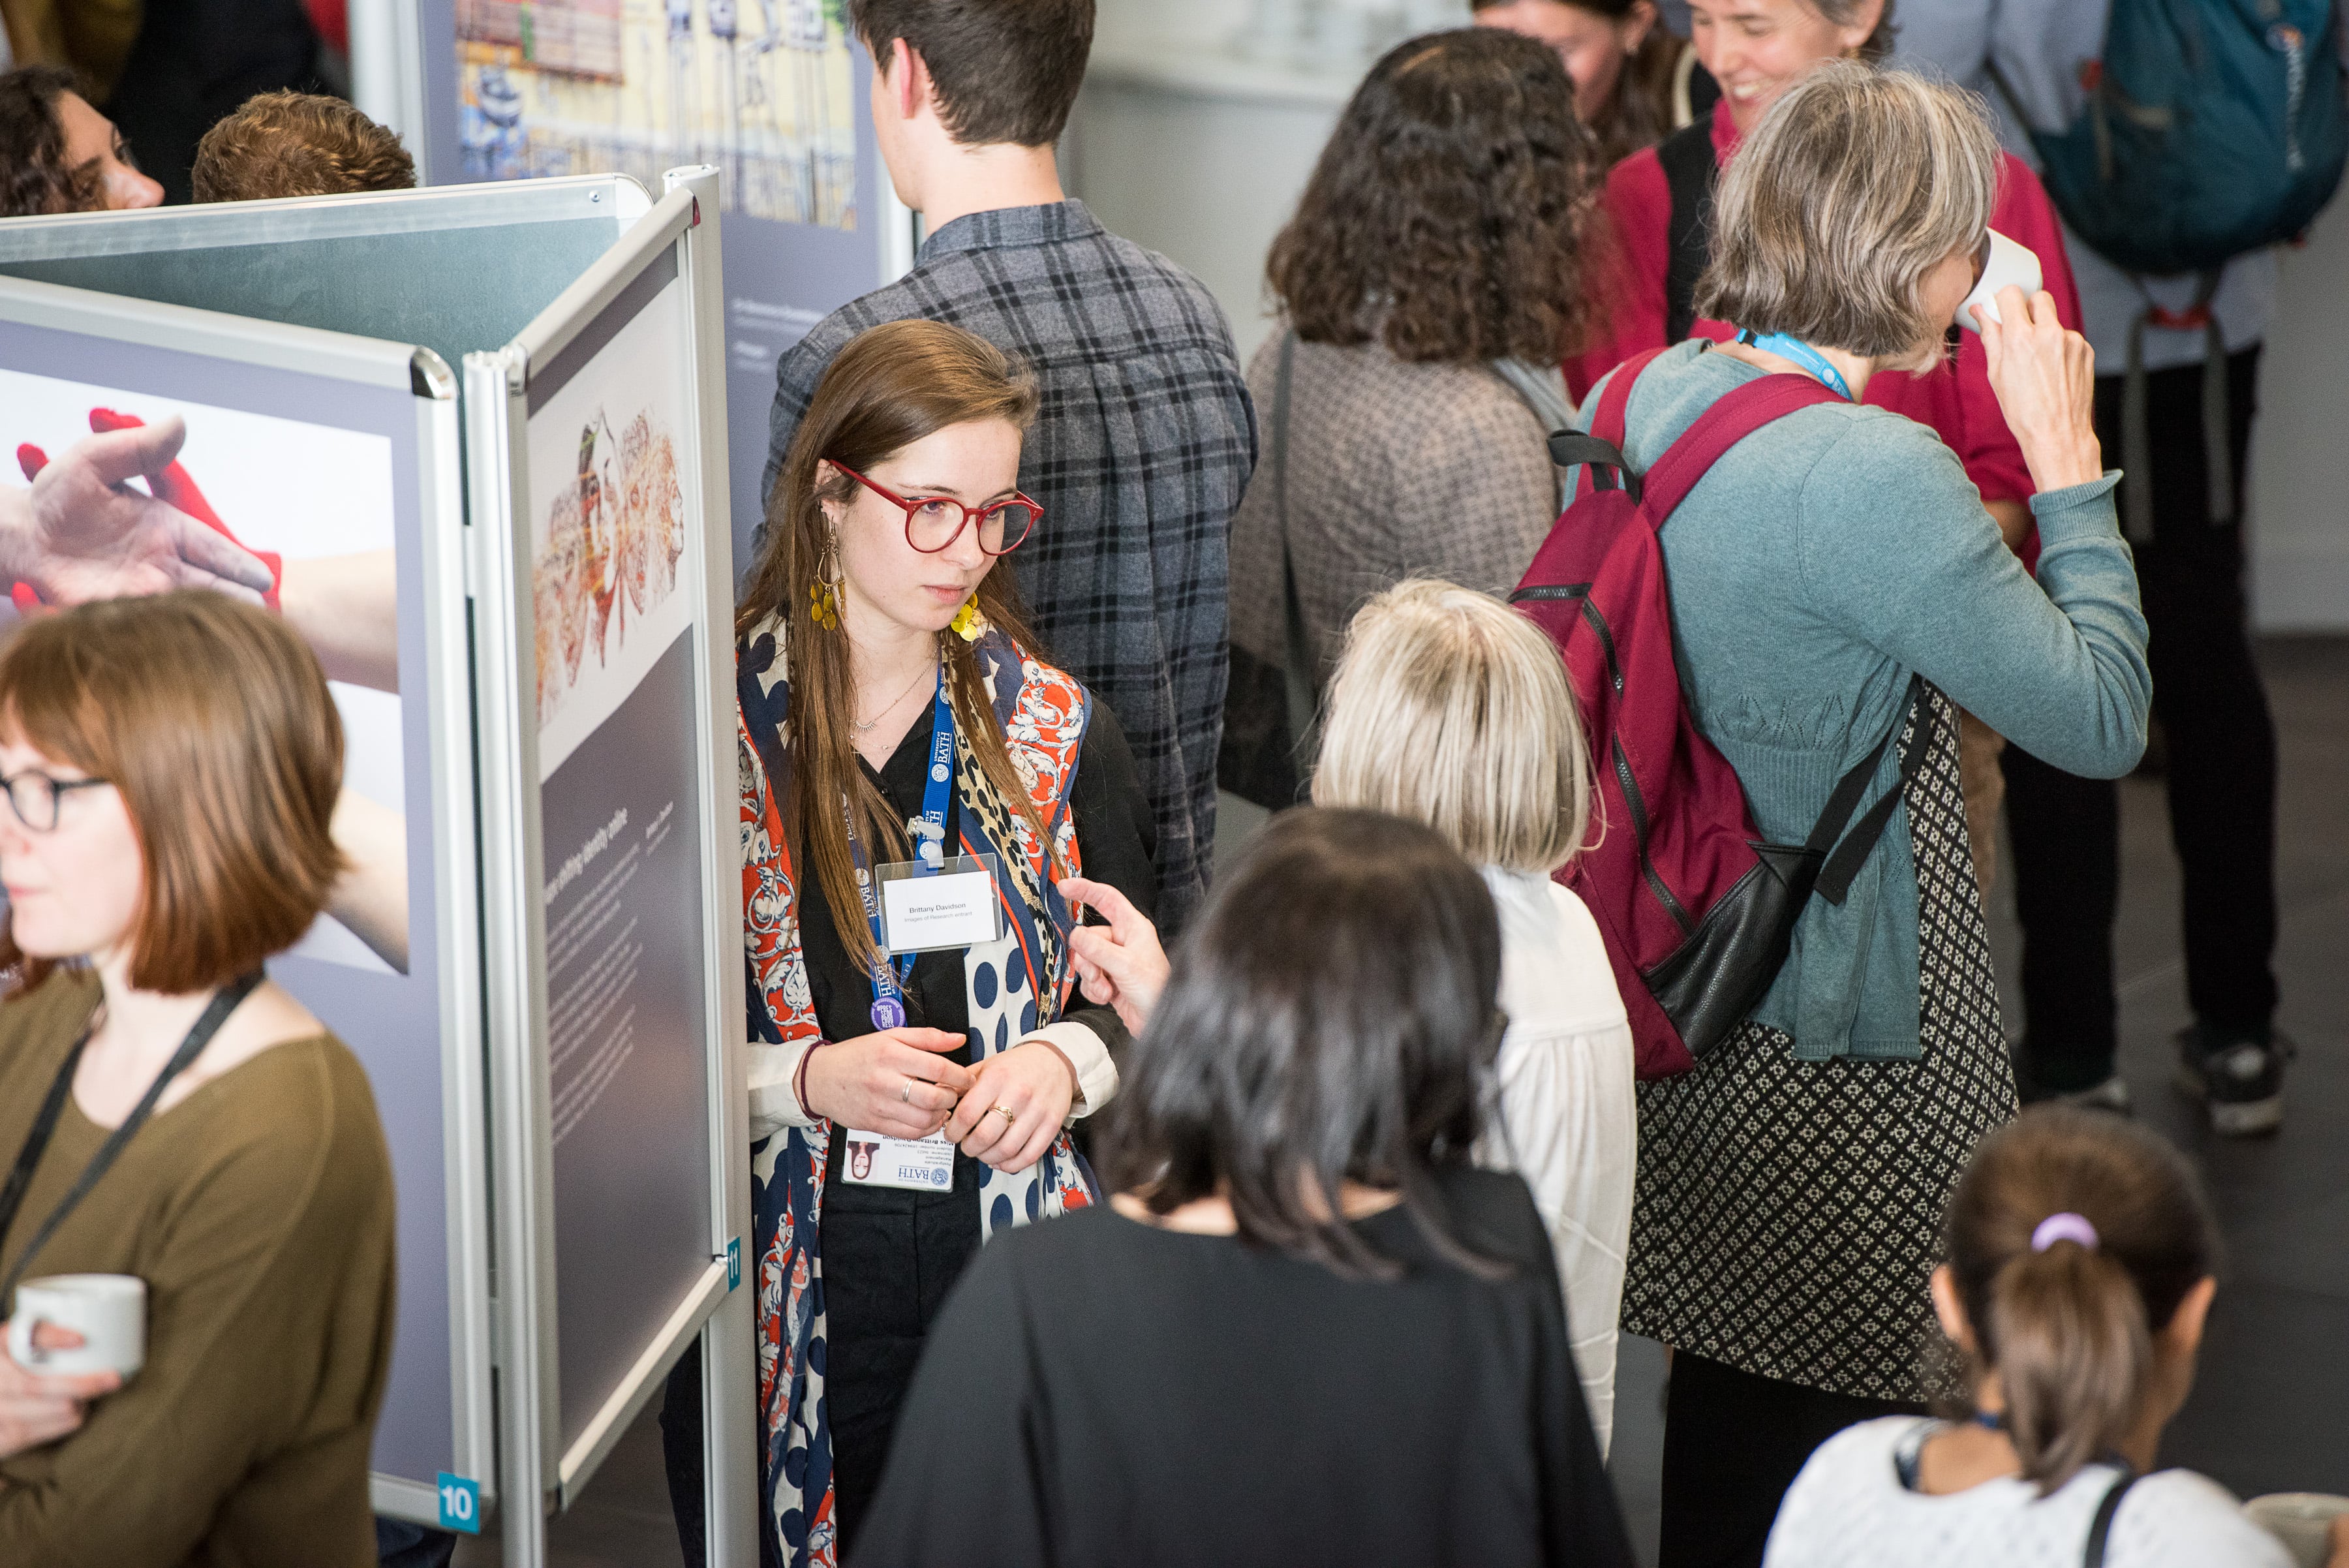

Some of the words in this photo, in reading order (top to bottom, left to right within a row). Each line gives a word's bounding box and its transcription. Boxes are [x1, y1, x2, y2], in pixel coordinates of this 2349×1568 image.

[938, 731, 950, 763] BATH
[861, 886, 877, 917] BATH
[936, 902, 966, 911] Davidson
[898, 1168, 929, 1180] BATH
[729, 1246, 738, 1280] 11
[441, 1484, 472, 1520] 10
